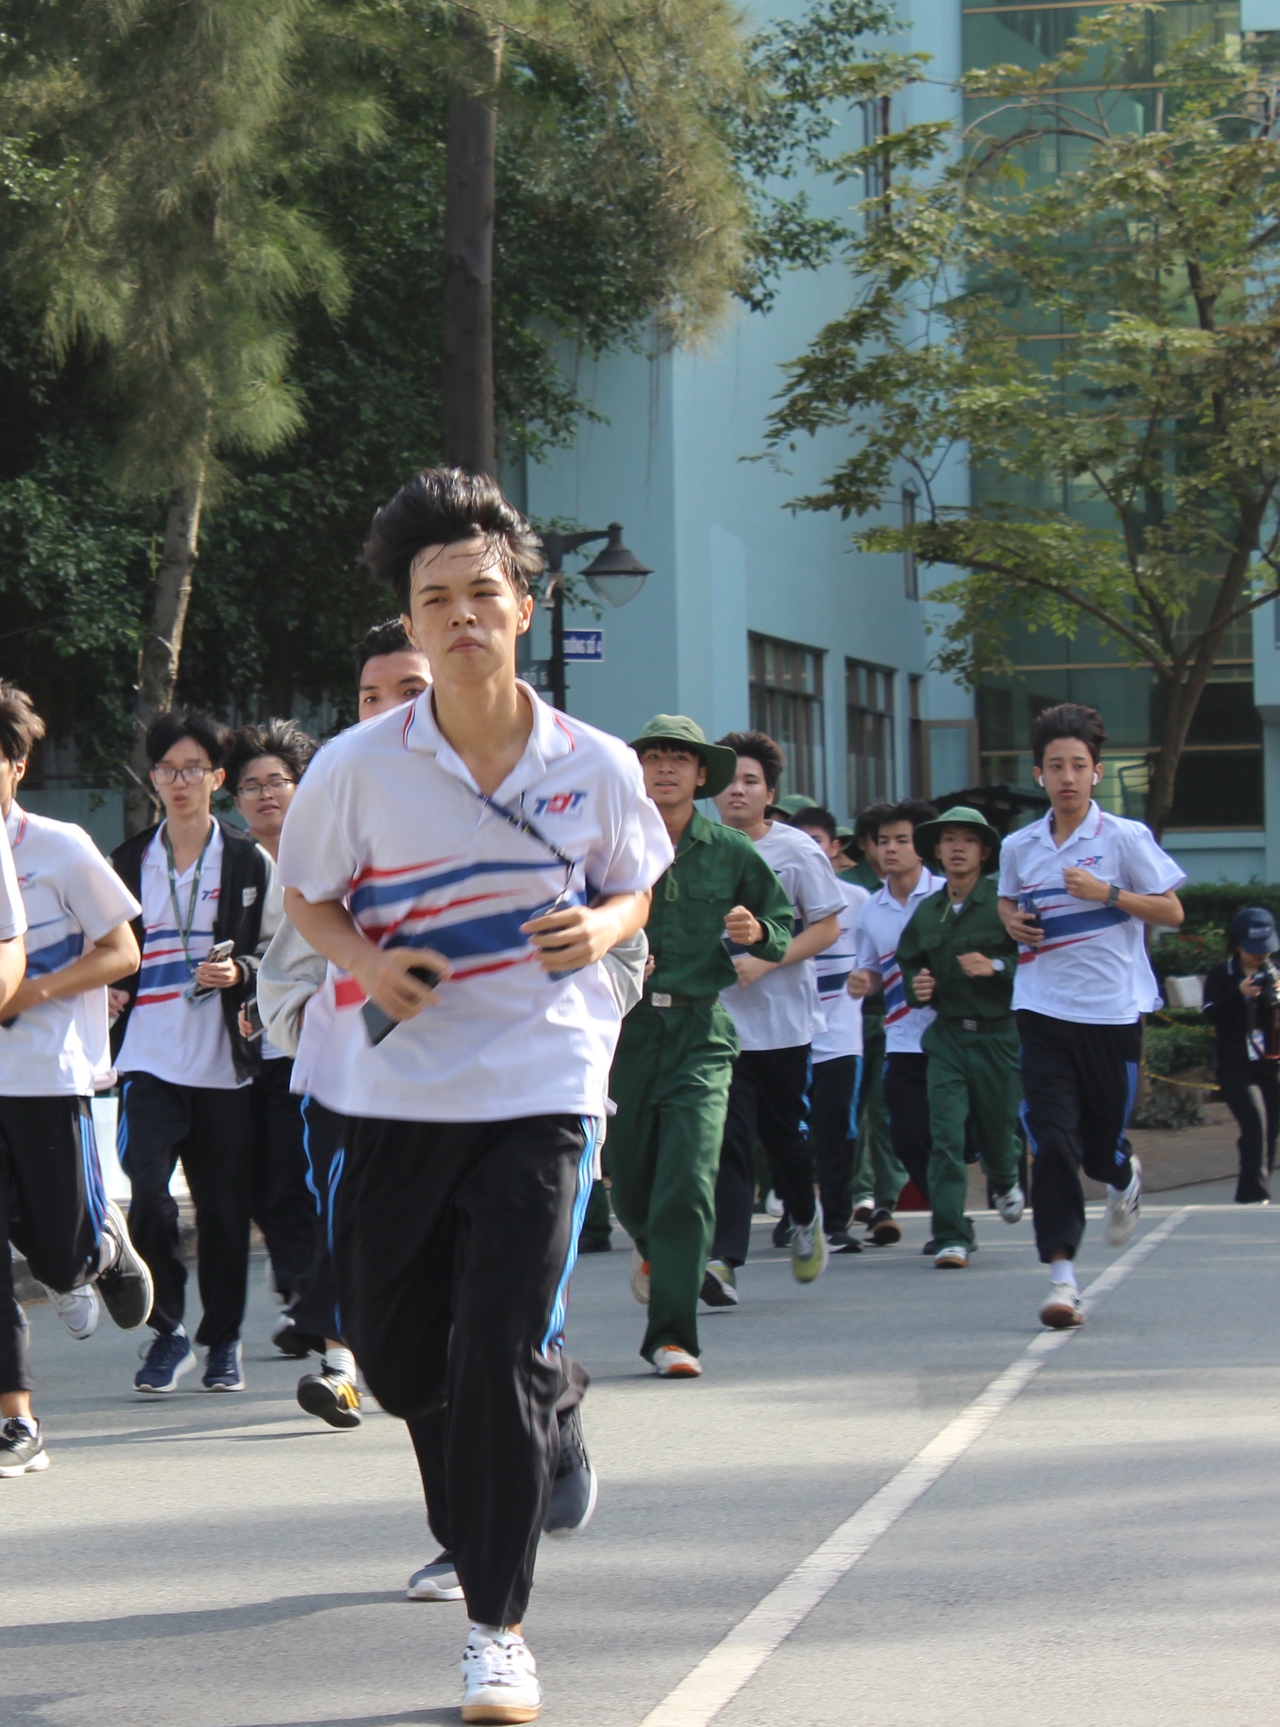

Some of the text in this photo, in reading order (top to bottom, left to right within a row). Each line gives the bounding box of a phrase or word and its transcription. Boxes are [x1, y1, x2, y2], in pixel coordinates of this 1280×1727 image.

[533, 790, 587, 816] TDT
[1075, 856, 1103, 868] TDT
[201, 887, 222, 901] TD
